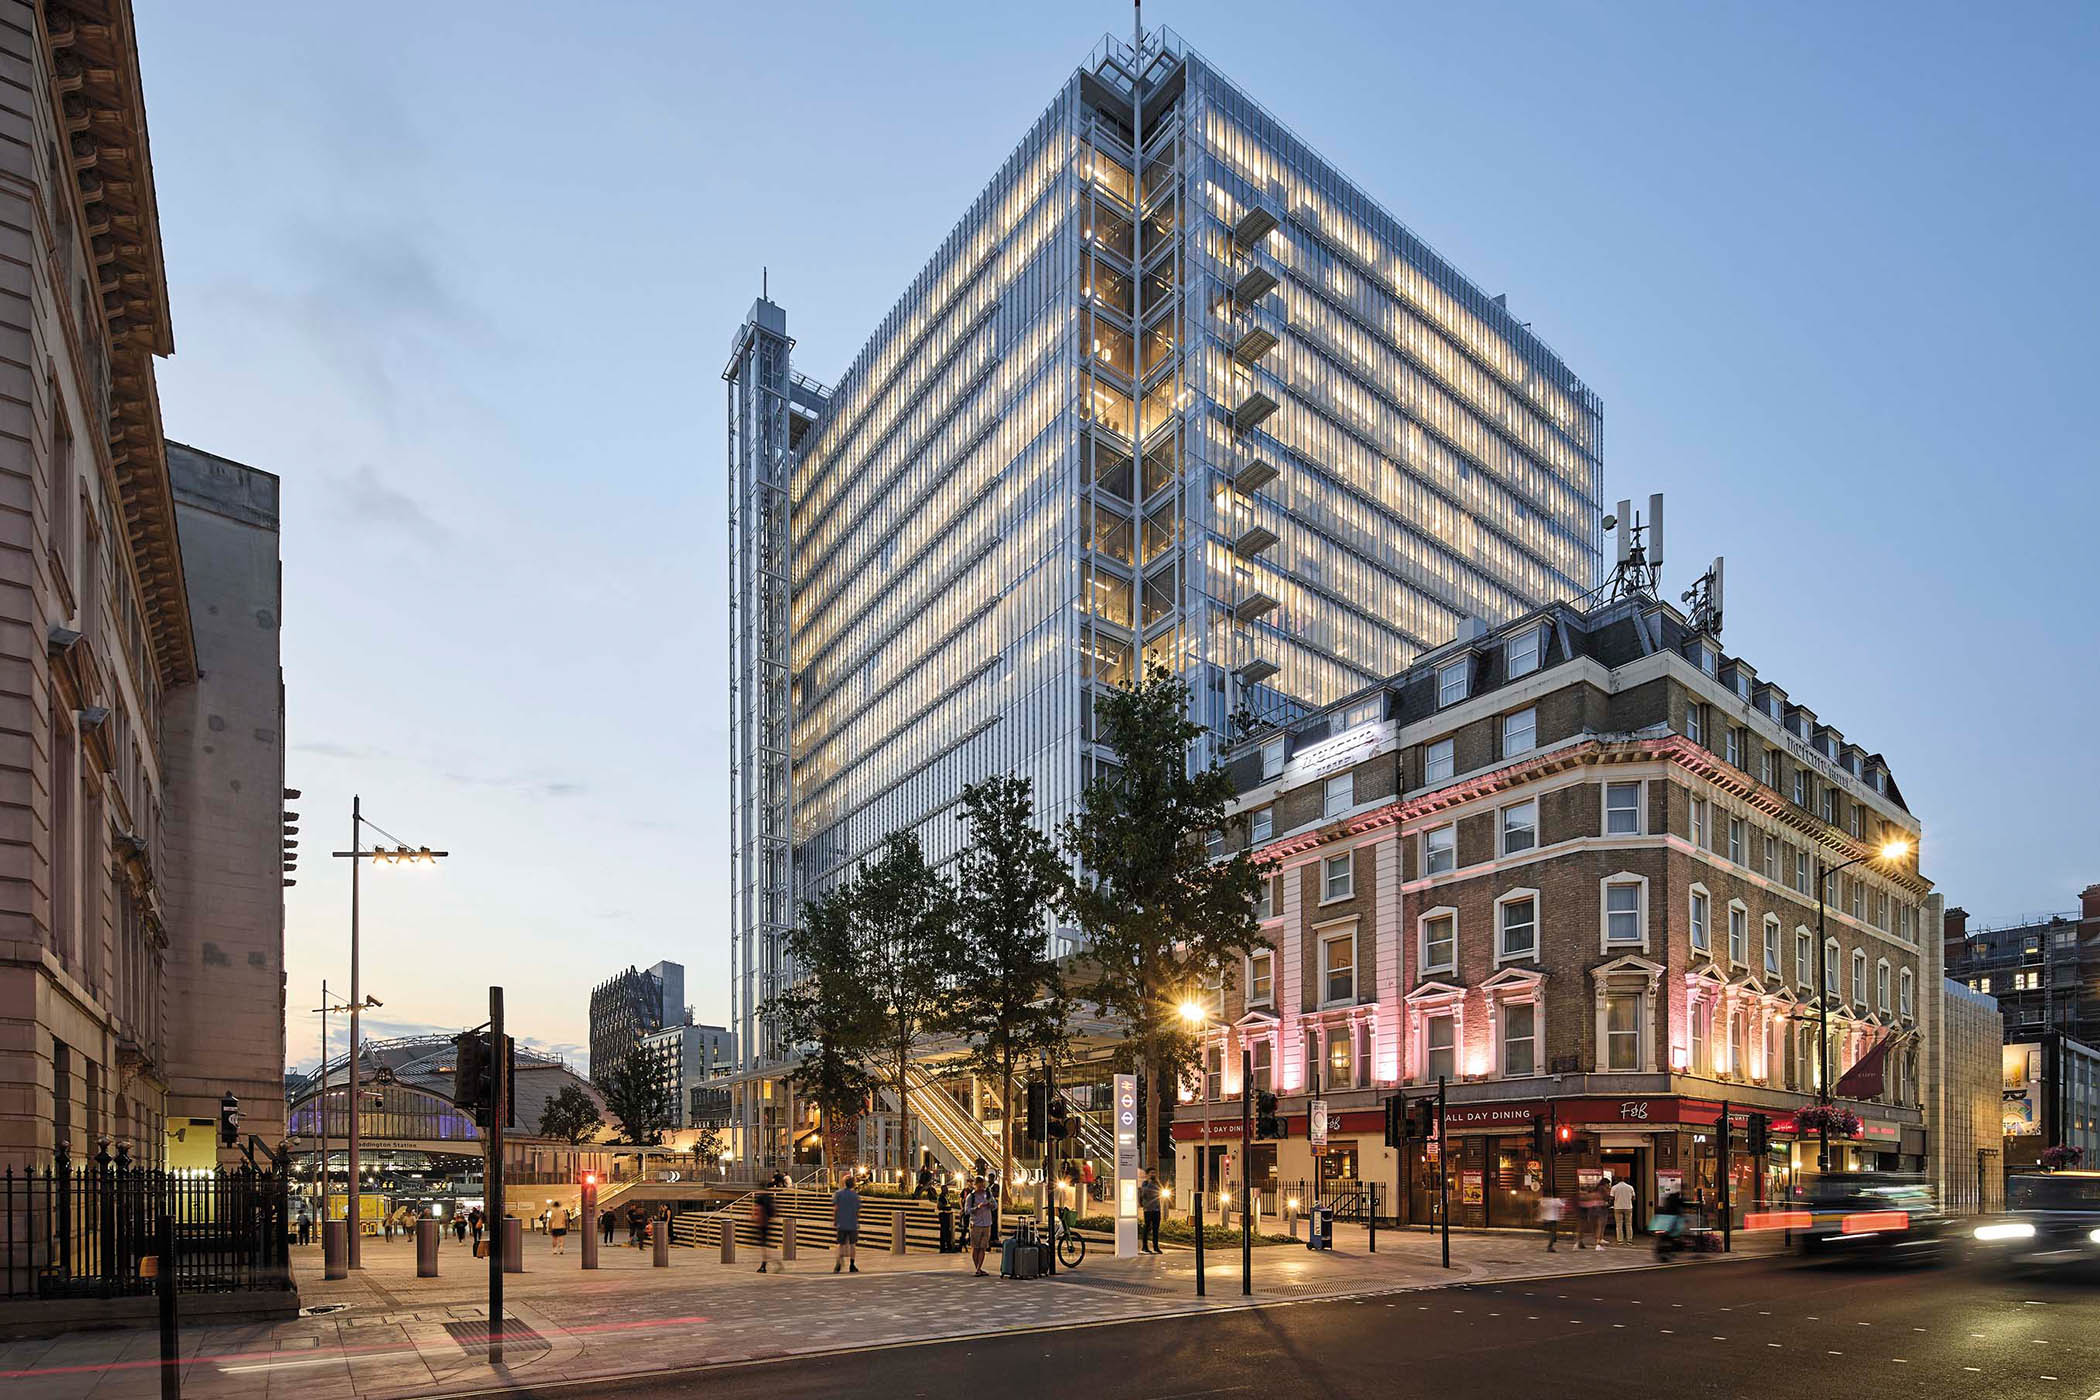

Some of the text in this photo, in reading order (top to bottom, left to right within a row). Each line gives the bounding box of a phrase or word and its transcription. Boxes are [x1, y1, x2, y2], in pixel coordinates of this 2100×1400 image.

[1316, 755, 1358, 777] HOTEL
[1445, 1110, 1530, 1122] ALL DAY DINING
[1620, 1101, 1649, 1120] F&B
[1327, 1115, 1341, 1130] &B
[1200, 1126, 1213, 1134] AL
[1214, 1126, 1228, 1134] DAY
[359, 1141, 391, 1149] addington
